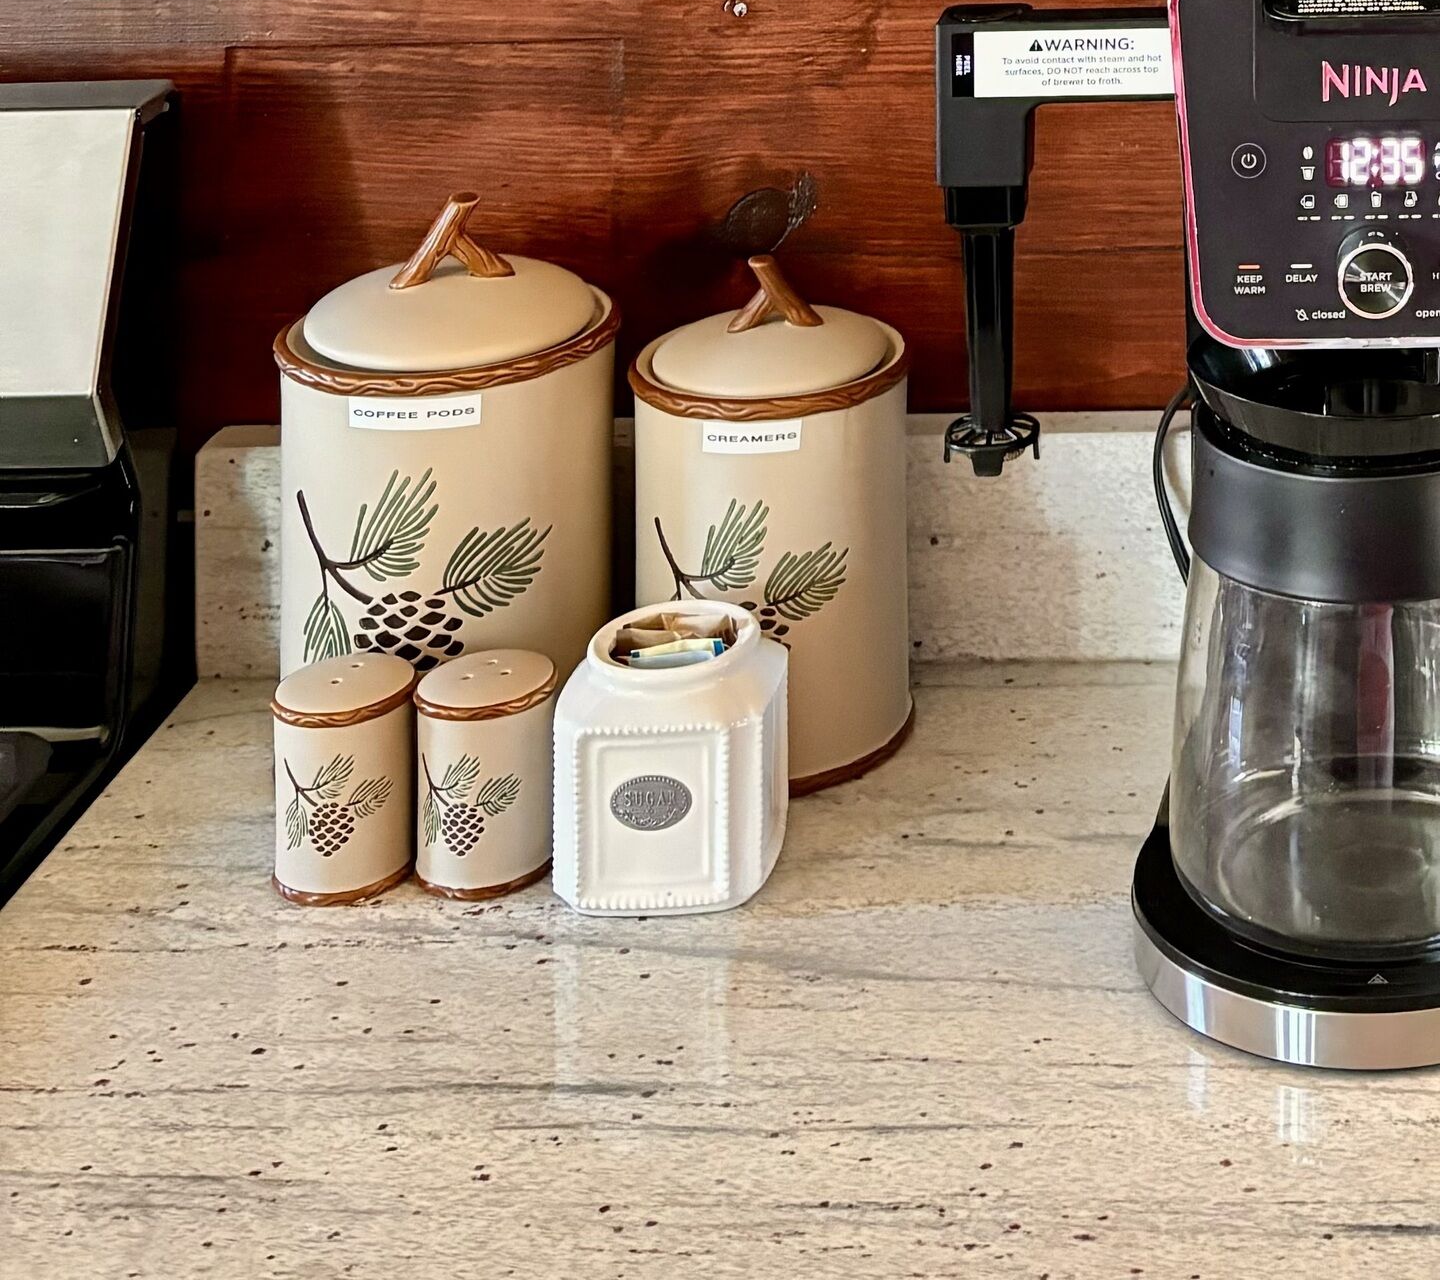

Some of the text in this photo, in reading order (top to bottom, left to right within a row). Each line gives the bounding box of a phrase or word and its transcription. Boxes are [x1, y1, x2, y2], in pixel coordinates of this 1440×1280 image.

[1044, 38, 1135, 52] WARNING:
[1002, 54, 1162, 65] To avoid contact with steam and hot
[1047, 67, 1061, 75] DO
[1064, 67, 1083, 75] NOT
[1085, 66, 1111, 74] reach
[1112, 66, 1141, 74] across
[1143, 65, 1159, 74] top
[1041, 78, 1051, 86] of
[1053, 78, 1085, 86] brewer
[1321, 60, 1427, 107] NINJA
[1236, 275, 1264, 284] KEEP
[1285, 274, 1318, 283] DELAY
[1359, 272, 1393, 282] START
[1233, 286, 1266, 295] WARM
[1360, 283, 1392, 293] BREW
[1311, 309, 1346, 319] closed
[353, 407, 475, 419] COFFEE PODS
[707, 432, 797, 443] CREAMERS
[624, 790, 675, 807] SUGAR
